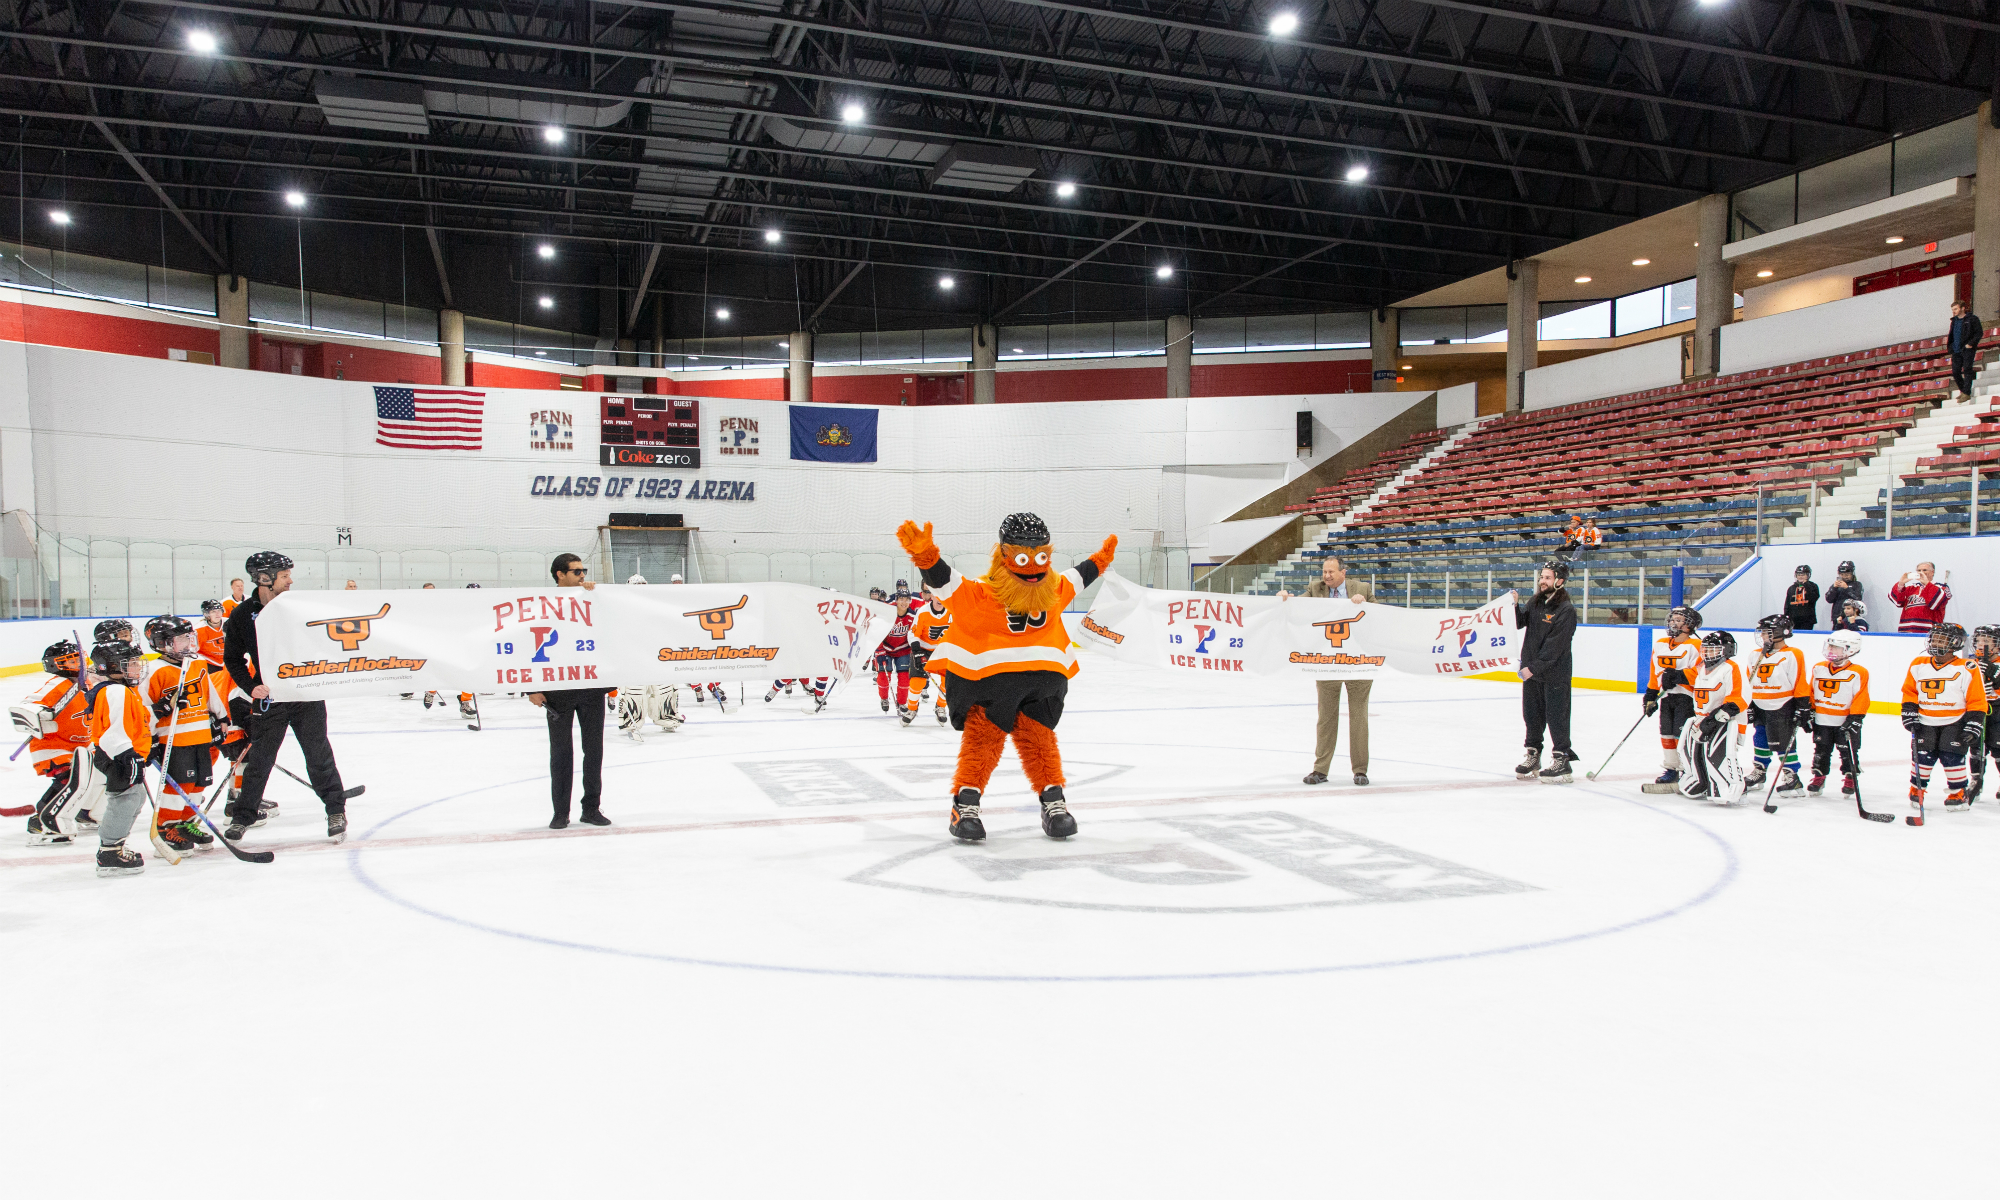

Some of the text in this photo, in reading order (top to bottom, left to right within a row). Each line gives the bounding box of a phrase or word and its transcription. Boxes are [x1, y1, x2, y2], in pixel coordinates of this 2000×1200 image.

[607, 397, 625, 405] HOME
[530, 410, 573, 427] PENN
[720, 417, 759, 433] PENN
[546, 424, 559, 441] P
[734, 431, 746, 446] P
[618, 449, 690, 464] Coke zero
[720, 447, 735, 455] ICE
[531, 476, 755, 500] CLASS OF 1923 ARENA
[338, 534, 352, 546] M
[492, 596, 593, 632] PENN
[1167, 599, 1244, 628] PENN
[1435, 606, 1504, 640] PENN
[530, 627, 559, 662] P
[576, 640, 595, 651] 23
[827, 634, 839, 646] 19
[1169, 634, 1183, 644] 19
[1194, 625, 1216, 654] P
[1229, 637, 1244, 648] 23
[1457, 628, 1477, 658] P
[1490, 636, 1506, 647] 23
[496, 642, 514, 654] 19
[1170, 654, 1244, 672] ICE RINK
[1435, 657, 1511, 673] ICE RINK
[296, 680, 320, 689] Building
[375, 674, 413, 682] Communities
[497, 665, 598, 684] ICE RINK
[54, 682, 79, 713] BAUER
[49, 787, 71, 816] CCM
